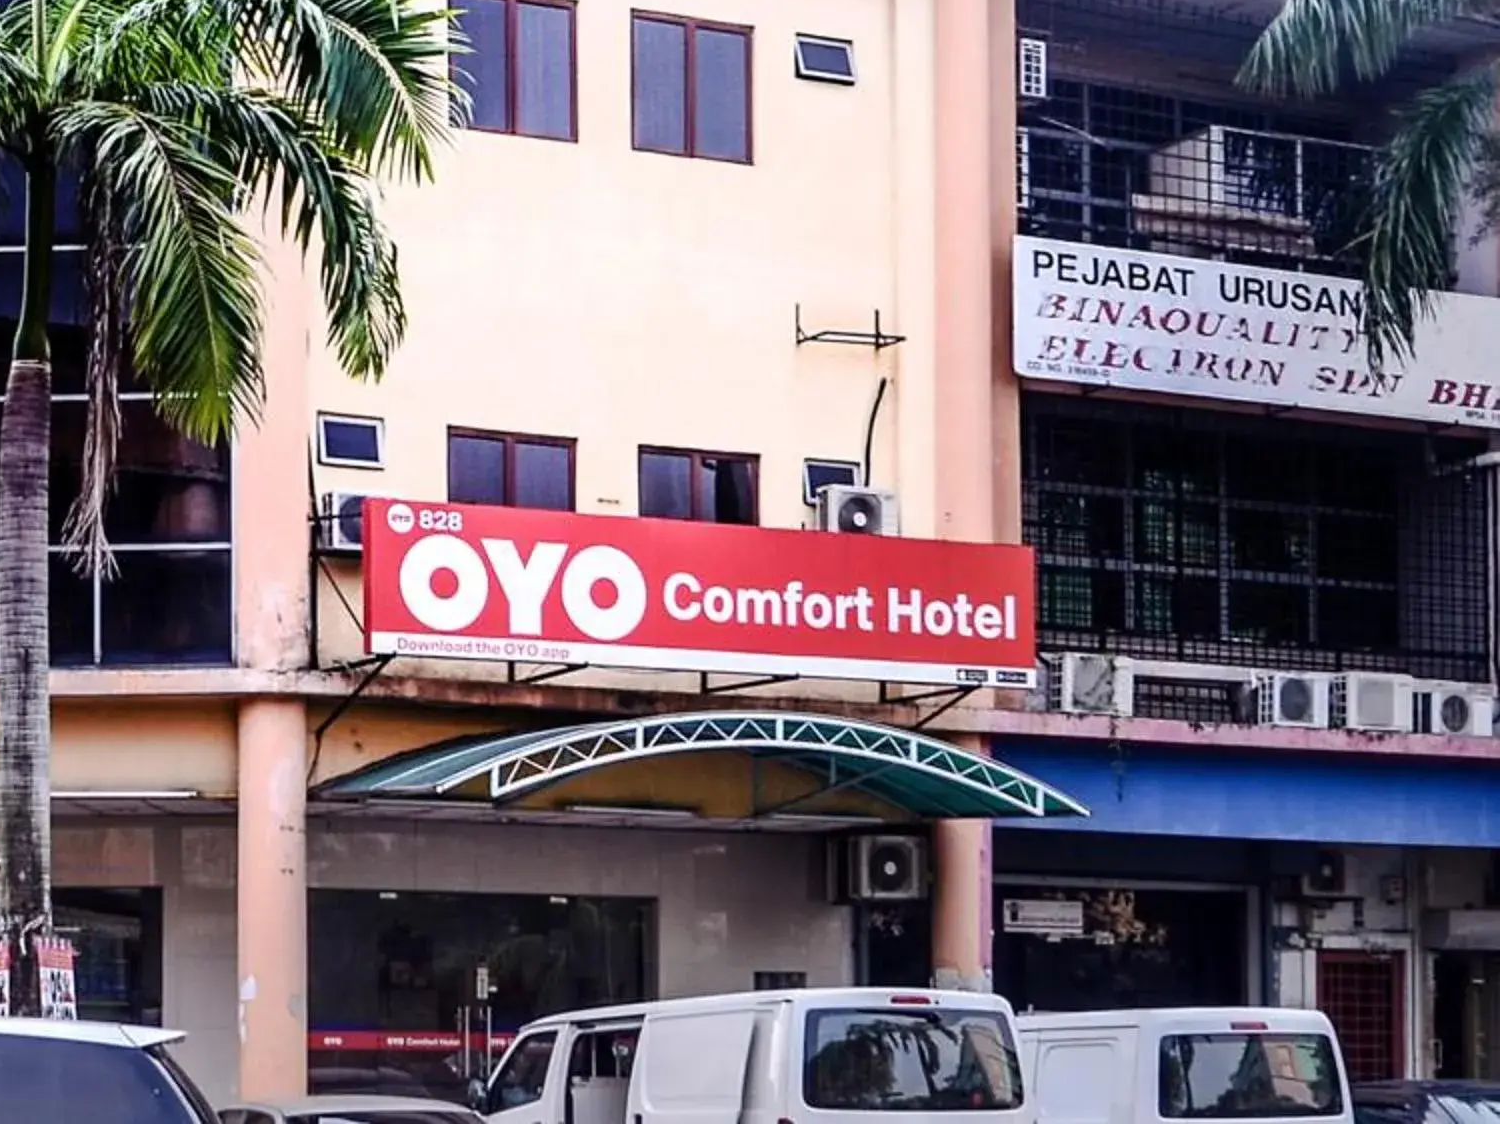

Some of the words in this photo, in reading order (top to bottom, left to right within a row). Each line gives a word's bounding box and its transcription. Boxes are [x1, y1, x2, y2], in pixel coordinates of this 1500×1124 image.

[1032, 250, 1194, 297] PEJABAT
[1219, 273, 1361, 320] URUSAN
[1428, 379, 1500, 413] BH
[419, 509, 463, 531] 828
[400, 533, 647, 641] OYO
[663, 572, 875, 632] Comfort
[887, 587, 1017, 640] Hotel
[397, 637, 473, 654] Download
[475, 643, 501, 656] the
[503, 643, 538, 658] OYO
[540, 648, 571, 660] app
